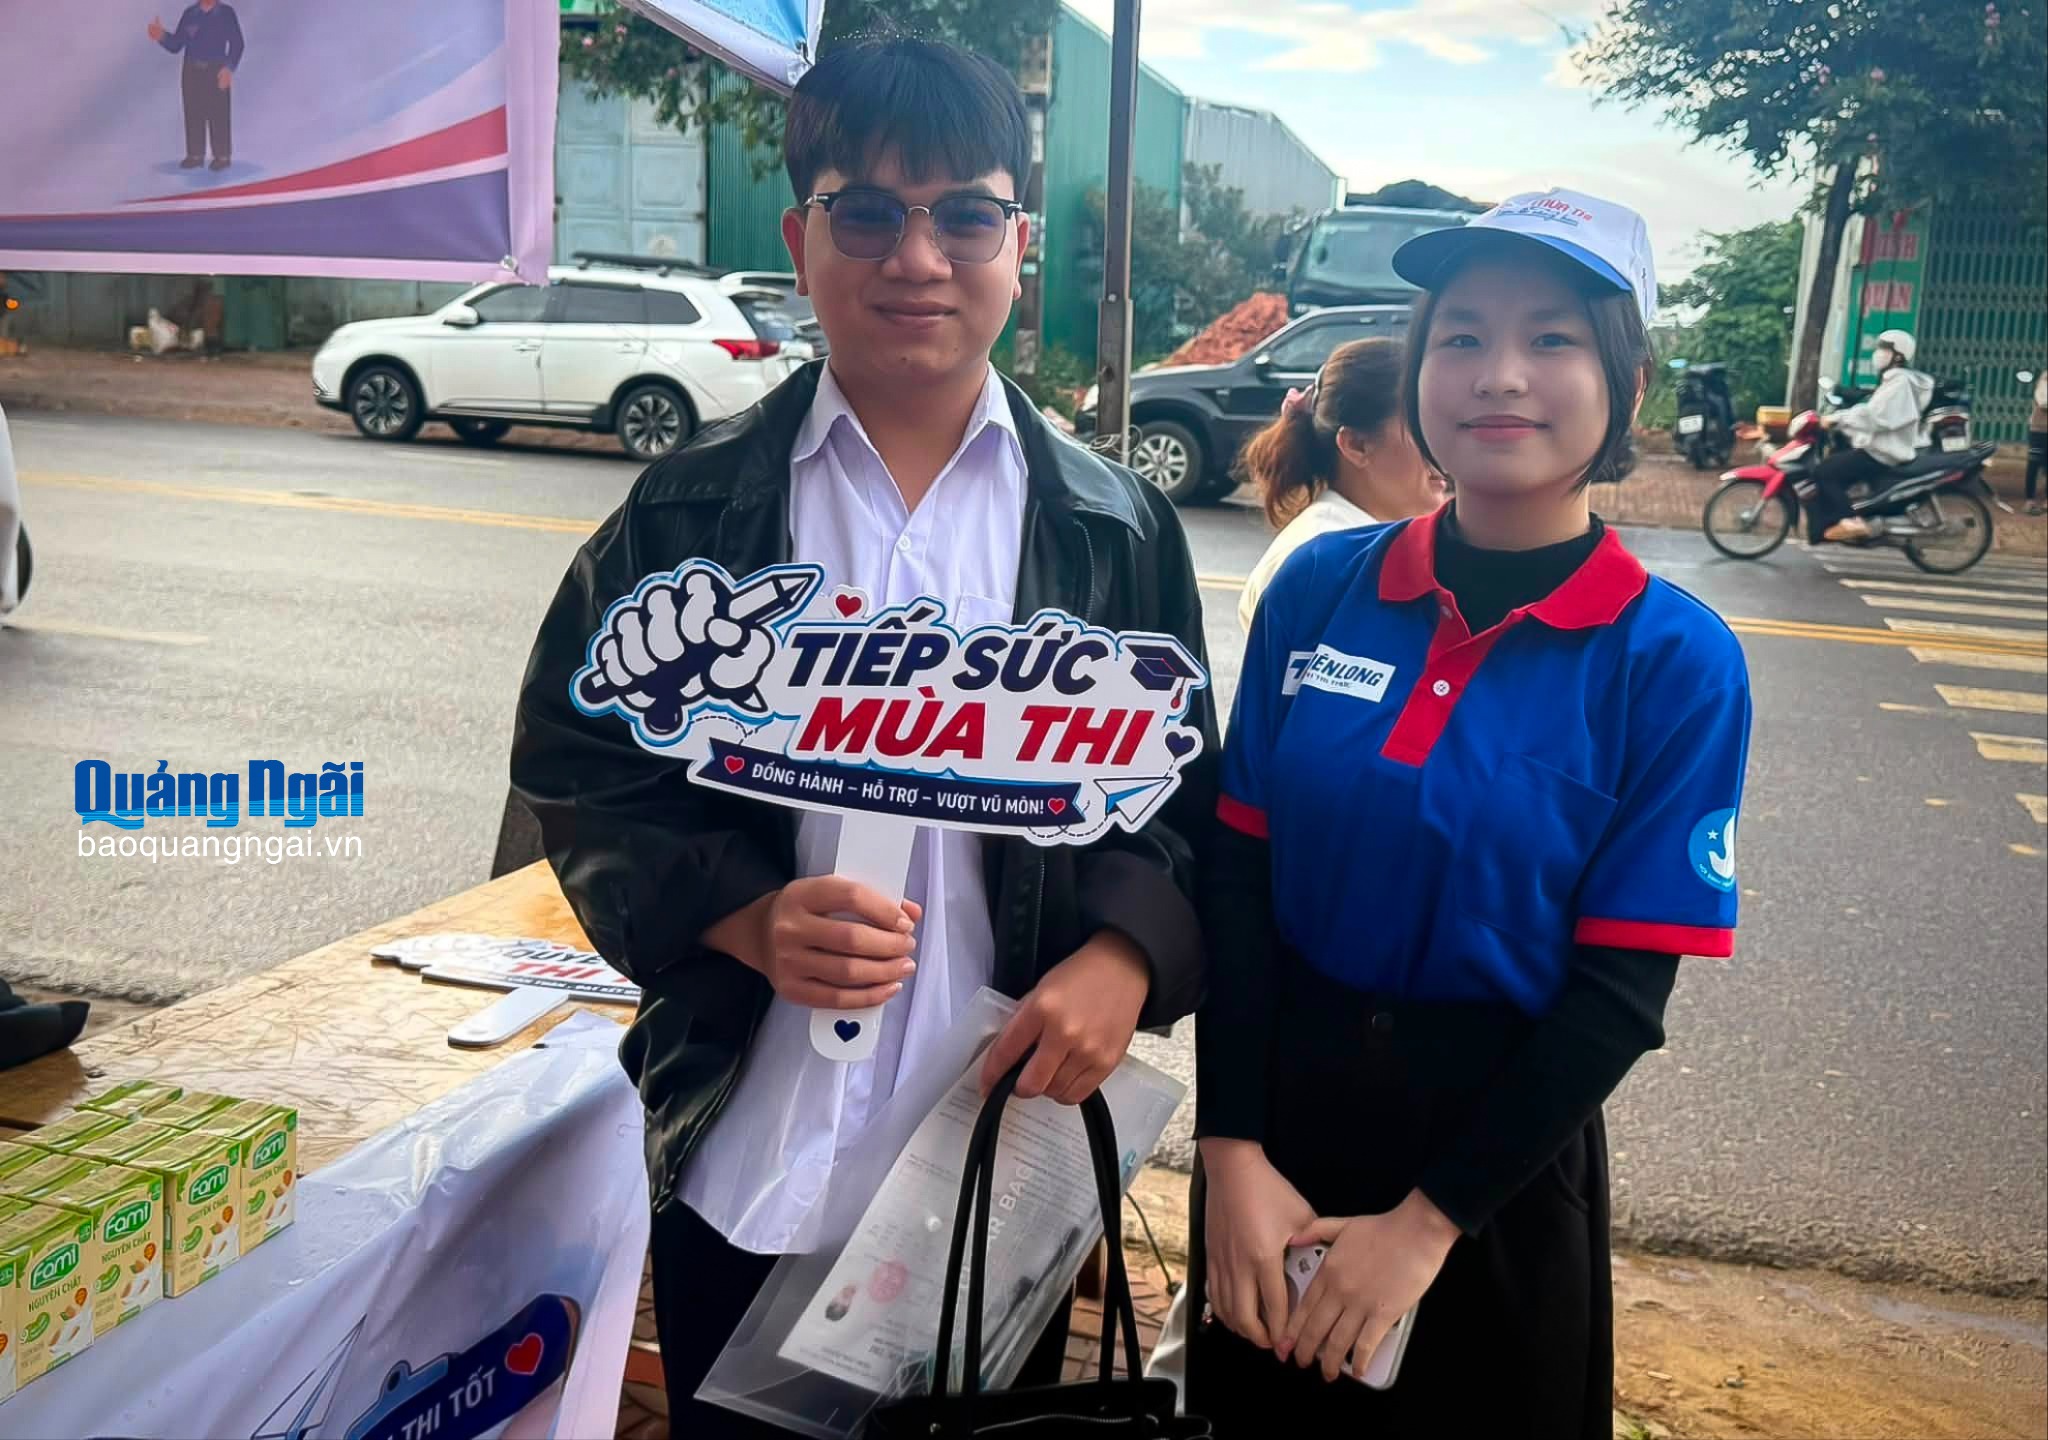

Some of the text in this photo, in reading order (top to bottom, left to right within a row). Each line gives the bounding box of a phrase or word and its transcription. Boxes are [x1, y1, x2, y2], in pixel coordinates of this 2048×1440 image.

[788, 607, 1109, 695] TIẾP SỨC
[796, 686, 1155, 767] MÙA THI
[888, 786, 919, 807] TRỢ
[937, 791, 978, 813] VƯỢT
[981, 795, 1001, 813] VŨ
[1005, 796, 1044, 815] MÔN!
[507, 962, 604, 979] THI
[255, 1137, 286, 1167] Fami
[191, 1170, 228, 1201] Fami
[106, 1202, 149, 1240] Fami
[33, 1244, 77, 1287] Fami
[401, 1365, 497, 1440] THI TỐT
